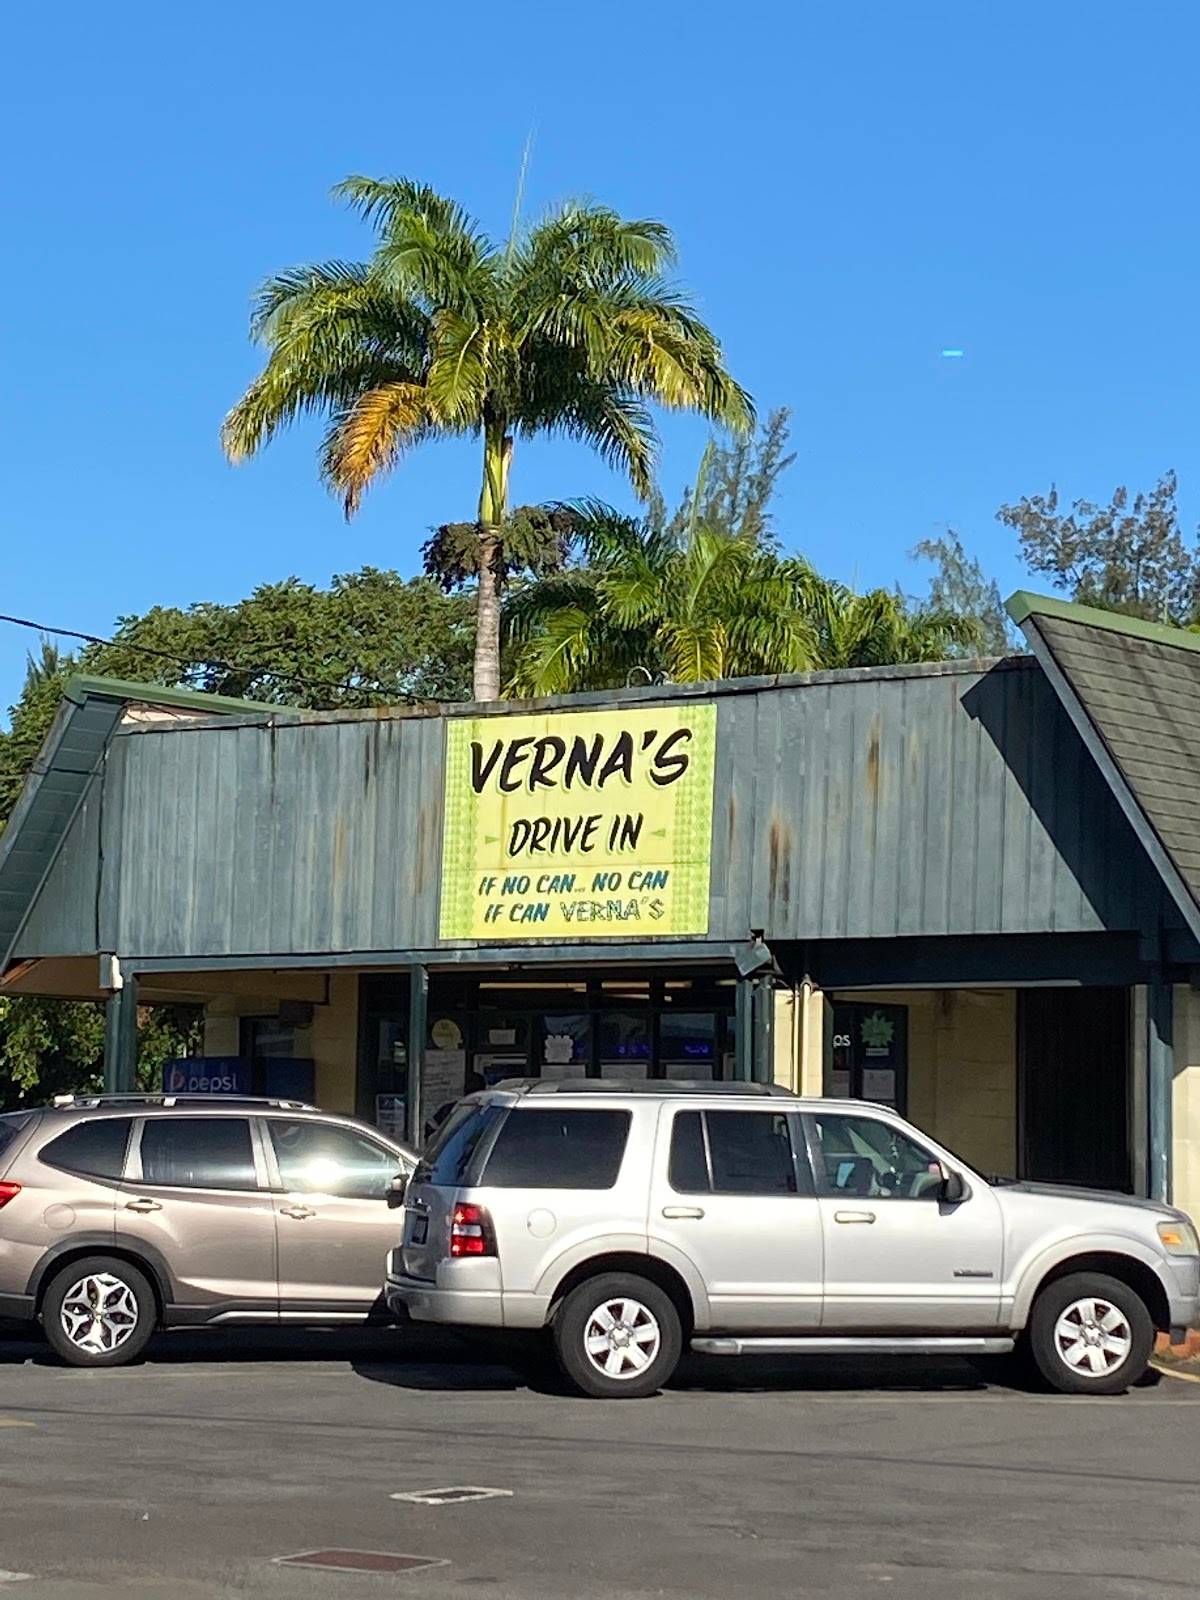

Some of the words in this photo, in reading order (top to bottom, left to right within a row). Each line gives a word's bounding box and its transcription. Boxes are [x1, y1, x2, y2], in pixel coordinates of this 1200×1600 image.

[470, 728, 693, 794] VERNA'S
[508, 814, 603, 857] DRIVE
[608, 812, 644, 850] IN
[478, 876, 497, 896] IF
[502, 875, 530, 895] NO
[592, 872, 622, 892] NO
[628, 870, 669, 891] CAN
[484, 903, 503, 923] IF
[509, 902, 550, 922] CAN
[560, 896, 665, 922] VERNA'S
[188, 1072, 238, 1093] pepsi
